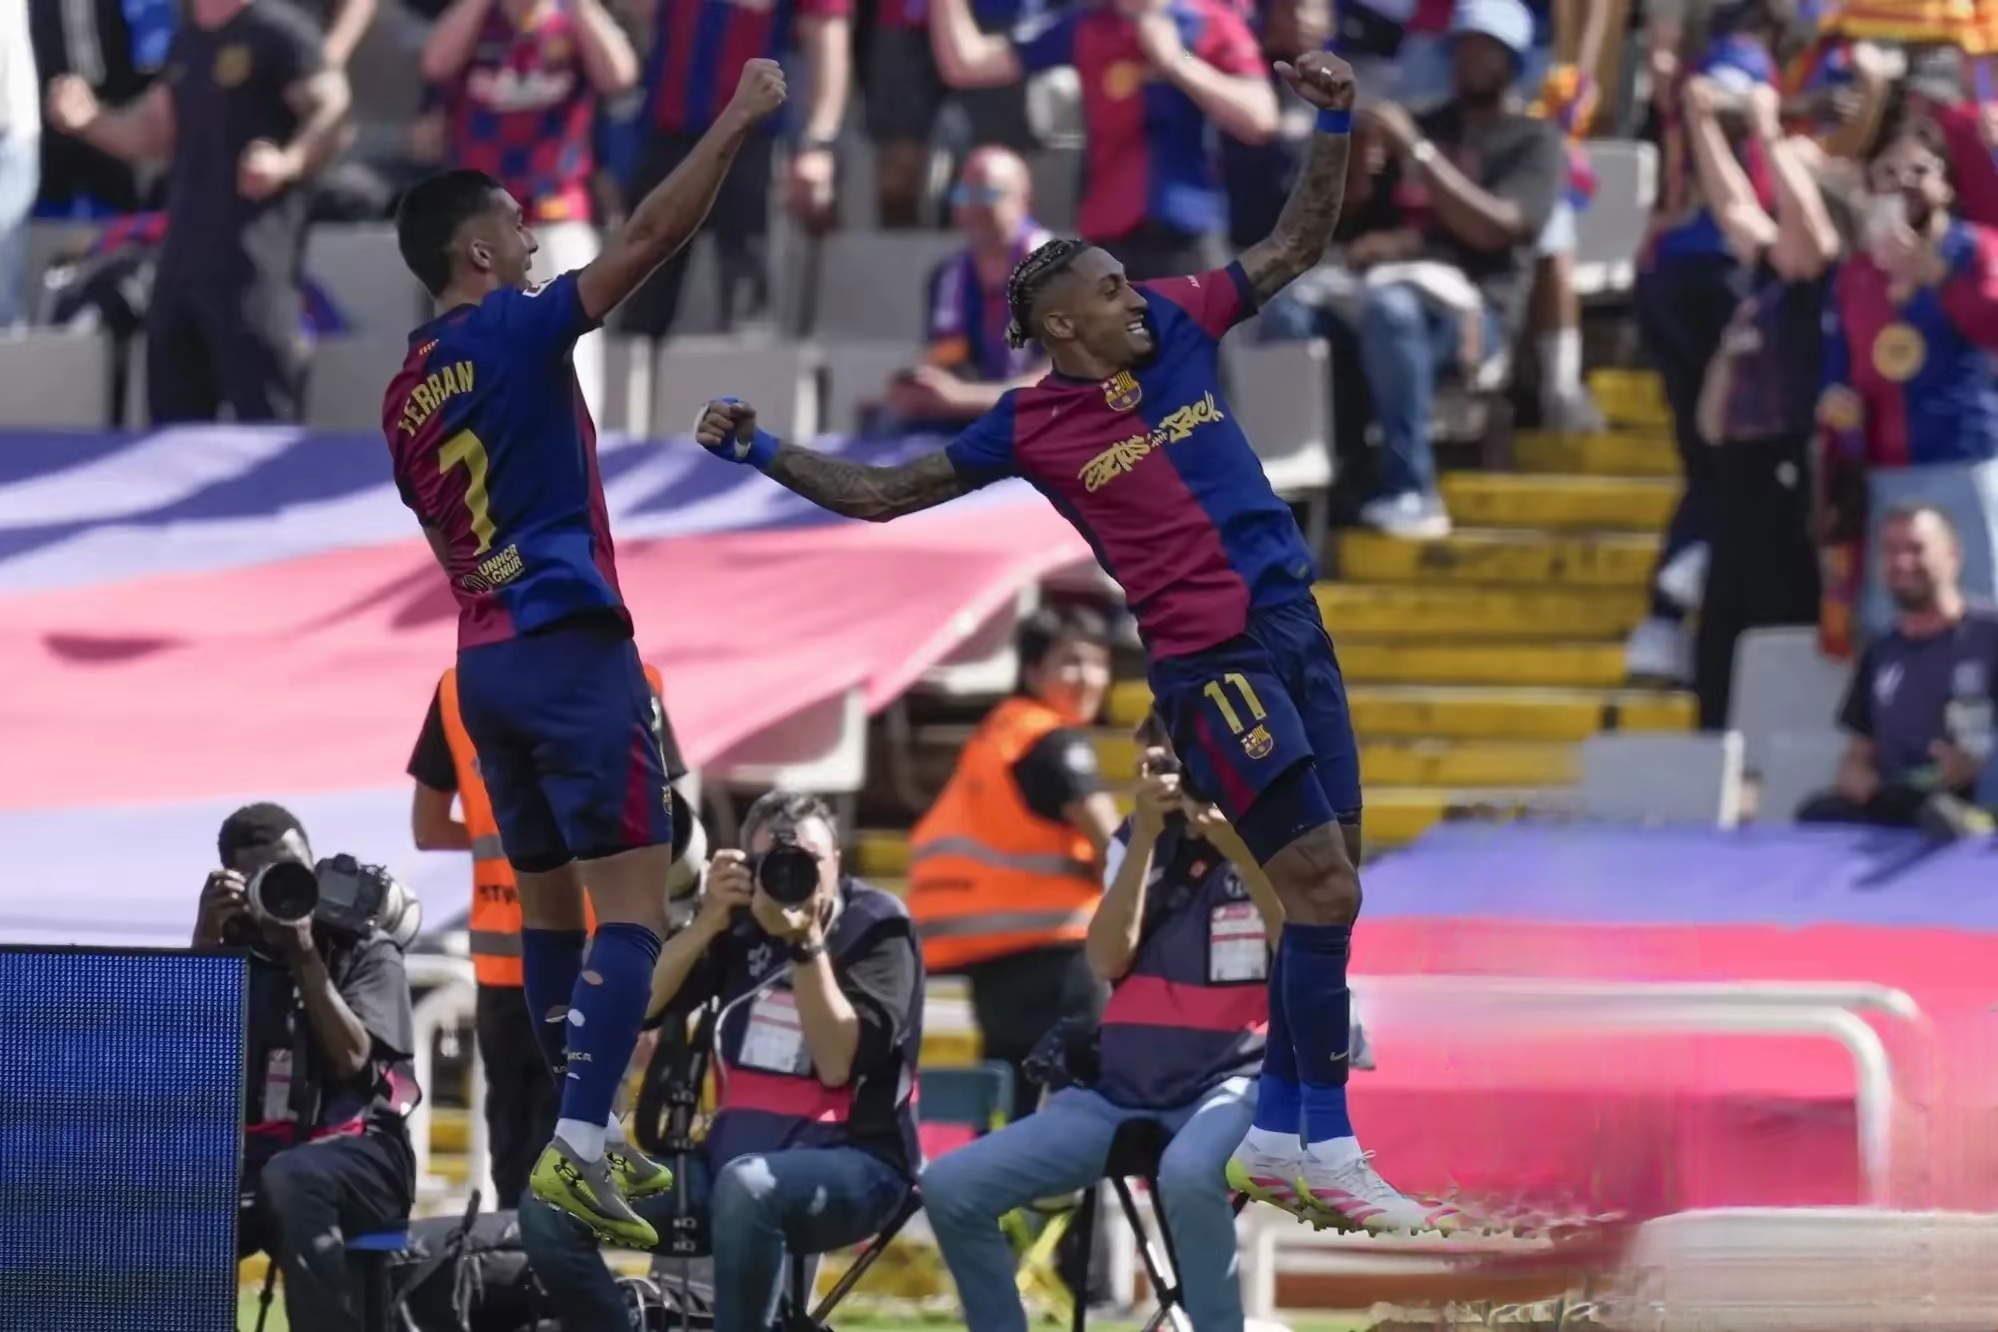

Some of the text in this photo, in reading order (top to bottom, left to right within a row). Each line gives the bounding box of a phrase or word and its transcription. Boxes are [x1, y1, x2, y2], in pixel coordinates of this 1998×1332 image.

[397, 360, 474, 437] FERRAN
[438, 427, 498, 557] 7
[1203, 672, 1267, 735] 11
